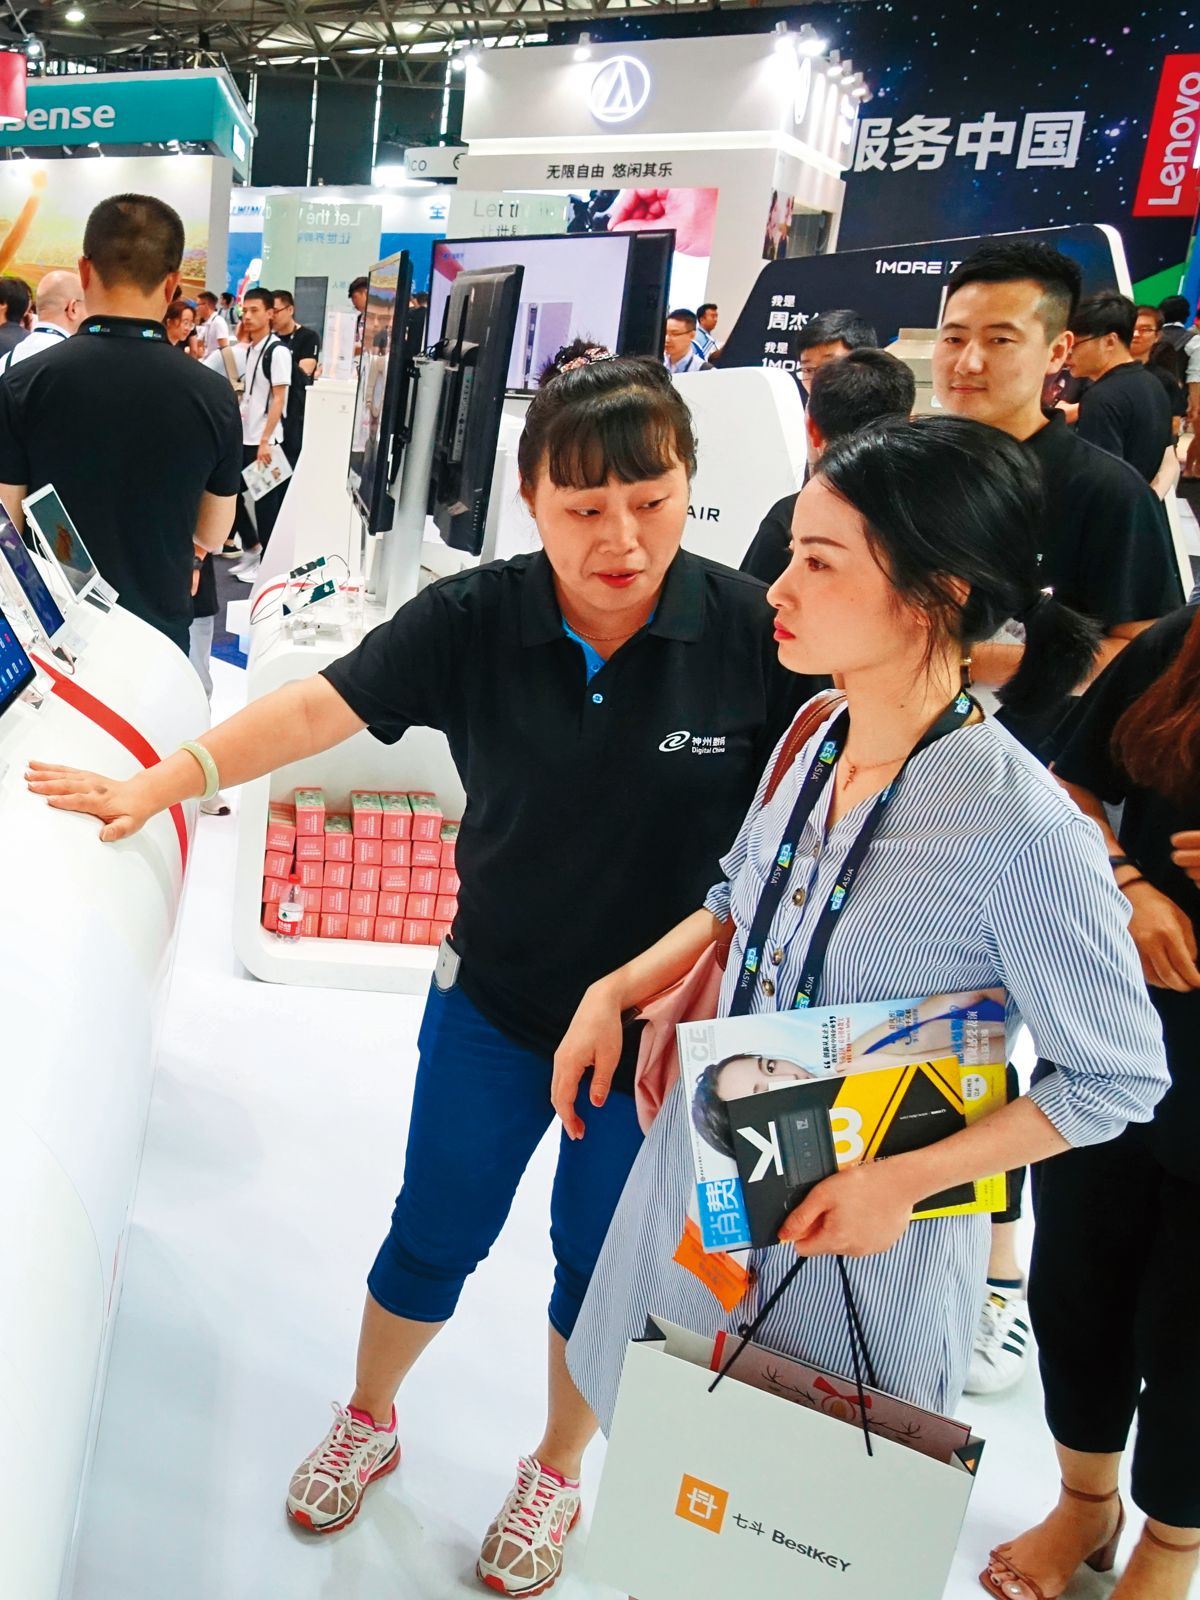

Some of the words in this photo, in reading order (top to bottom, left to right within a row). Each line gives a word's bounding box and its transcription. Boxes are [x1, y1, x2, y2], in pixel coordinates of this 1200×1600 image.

[853, 111, 1086, 172] 服务中国
[1148, 72, 1200, 205] Lenovo
[546, 164, 604, 179] 无限自由
[612, 162, 672, 178] 悠闲其乐
[429, 203, 447, 220] 全
[875, 259, 942, 275] 1MORE
[771, 295, 796, 308] 我是
[767, 311, 819, 331] 周杰
[764, 342, 788, 355] 我是
[761, 357, 801, 372] 1MO
[687, 505, 720, 522] AIR
[820, 740, 837, 764] CES
[810, 761, 825, 781] ASIA
[769, 865, 783, 885] ASIA
[842, 868, 854, 888] ASIA
[740, 968, 752, 989] ASIA
[795, 992, 810, 1009] ES
[804, 974, 816, 995] ASIA
[732, 1513, 766, 1536] 七斗
[771, 1529, 852, 1572] BestKEY
